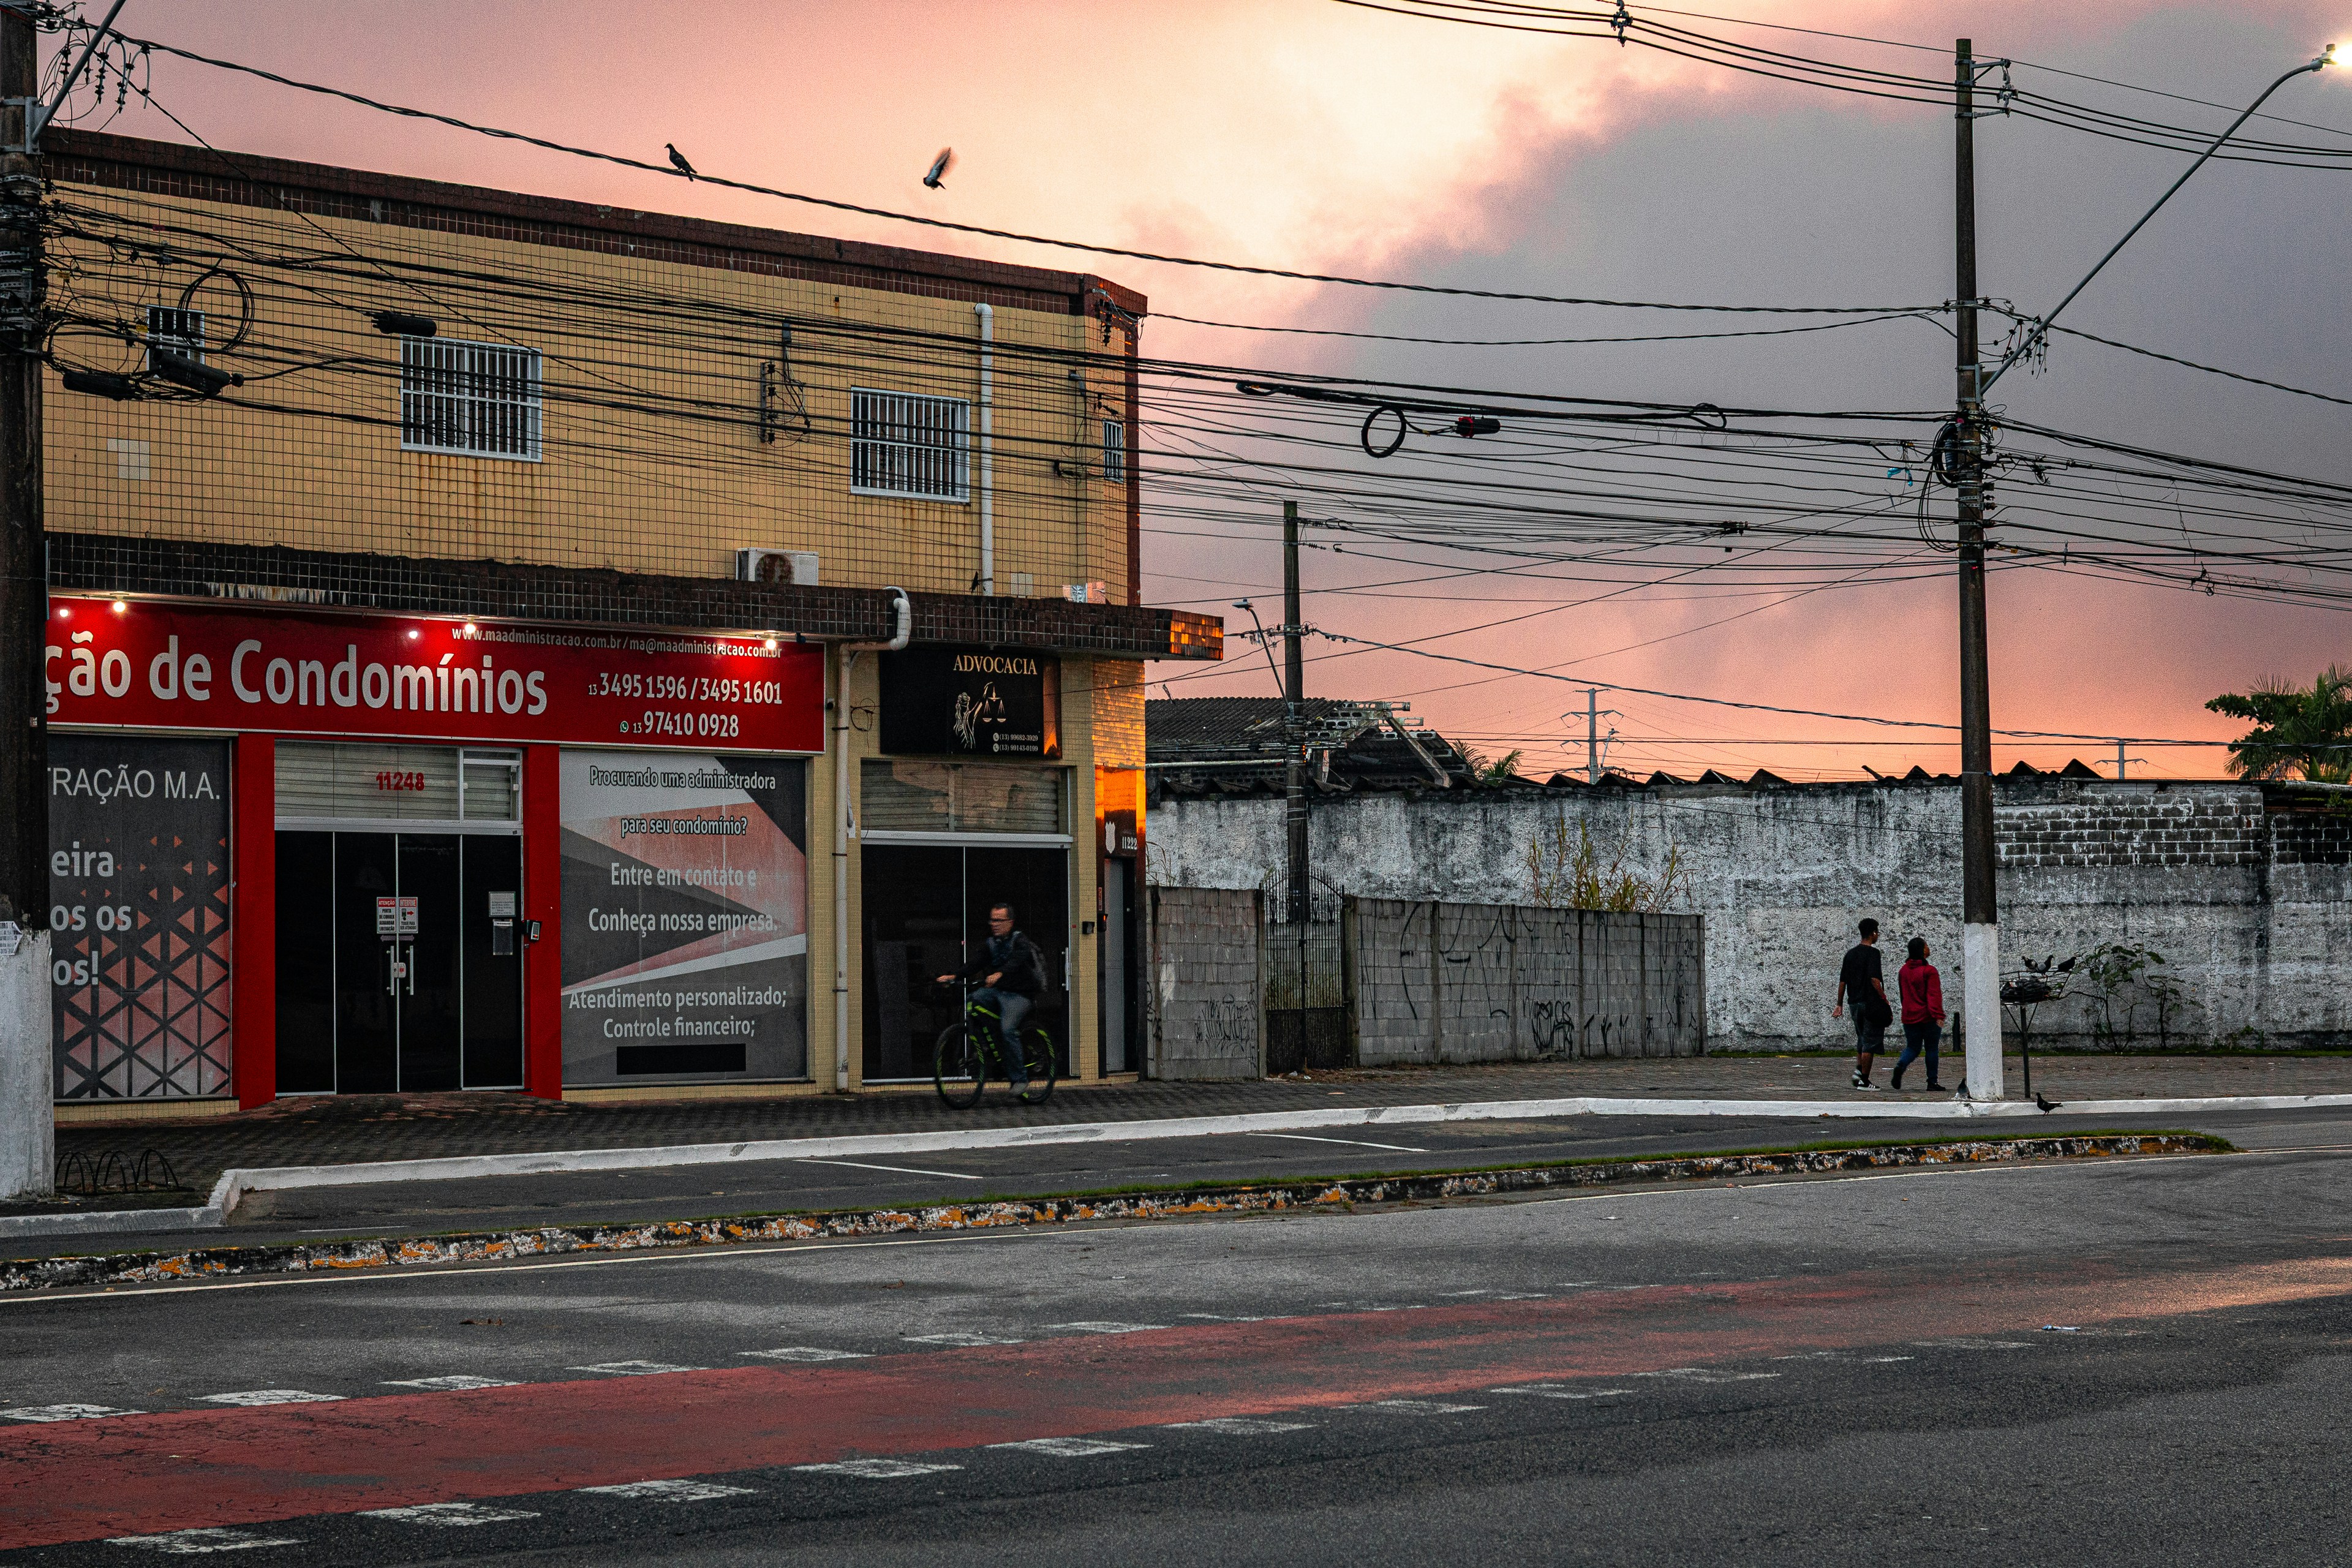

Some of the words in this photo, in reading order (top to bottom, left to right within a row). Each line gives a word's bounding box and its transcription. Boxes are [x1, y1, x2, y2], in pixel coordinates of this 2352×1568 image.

[452, 628, 620, 649] www.maadministracao.com.br
[630, 639, 782, 658] ma@maadministracao.com.br
[45, 630, 131, 714] ção
[149, 635, 211, 701] de
[231, 639, 547, 716] Condomínios
[953, 655, 1038, 675] ADVOCACIA
[589, 684, 597, 695] 13
[600, 673, 642, 697] 3495
[646, 676, 687, 699] 1596
[690, 677, 698, 700] /
[700, 678, 740, 703] 3495
[744, 680, 782, 704] 1601
[633, 723, 642, 733] 13
[644, 710, 694, 736] 97410
[698, 713, 739, 737] 0928
[47, 764, 155, 804] RAÇÃO
[164, 771, 221, 799] M.A.
[375, 772, 425, 791] 11248
[589, 766, 659, 788] Procurando
[660, 772, 687, 788] uma
[688, 769, 777, 790] administradora
[620, 817, 648, 839] para
[649, 819, 671, 834] seu
[672, 816, 748, 836] condomínio?
[1122, 836, 1137, 850] 11222
[51, 842, 114, 876] eira
[611, 862, 652, 886] Entre
[657, 870, 681, 886] em
[685, 867, 744, 886] contato
[747, 872, 756, 886] e
[50, 905, 87, 931] os
[96, 905, 132, 932] os
[589, 908, 655, 937] Conheça
[660, 913, 704, 930] nossa
[707, 913, 778, 938] empresa.
[53, 951, 99, 986] os!
[569, 988, 671, 1009] Atendimento
[676, 986, 787, 1011] personalizado;
[603, 1017, 670, 1038] Controle
[674, 1016, 756, 1036] financeiro;
